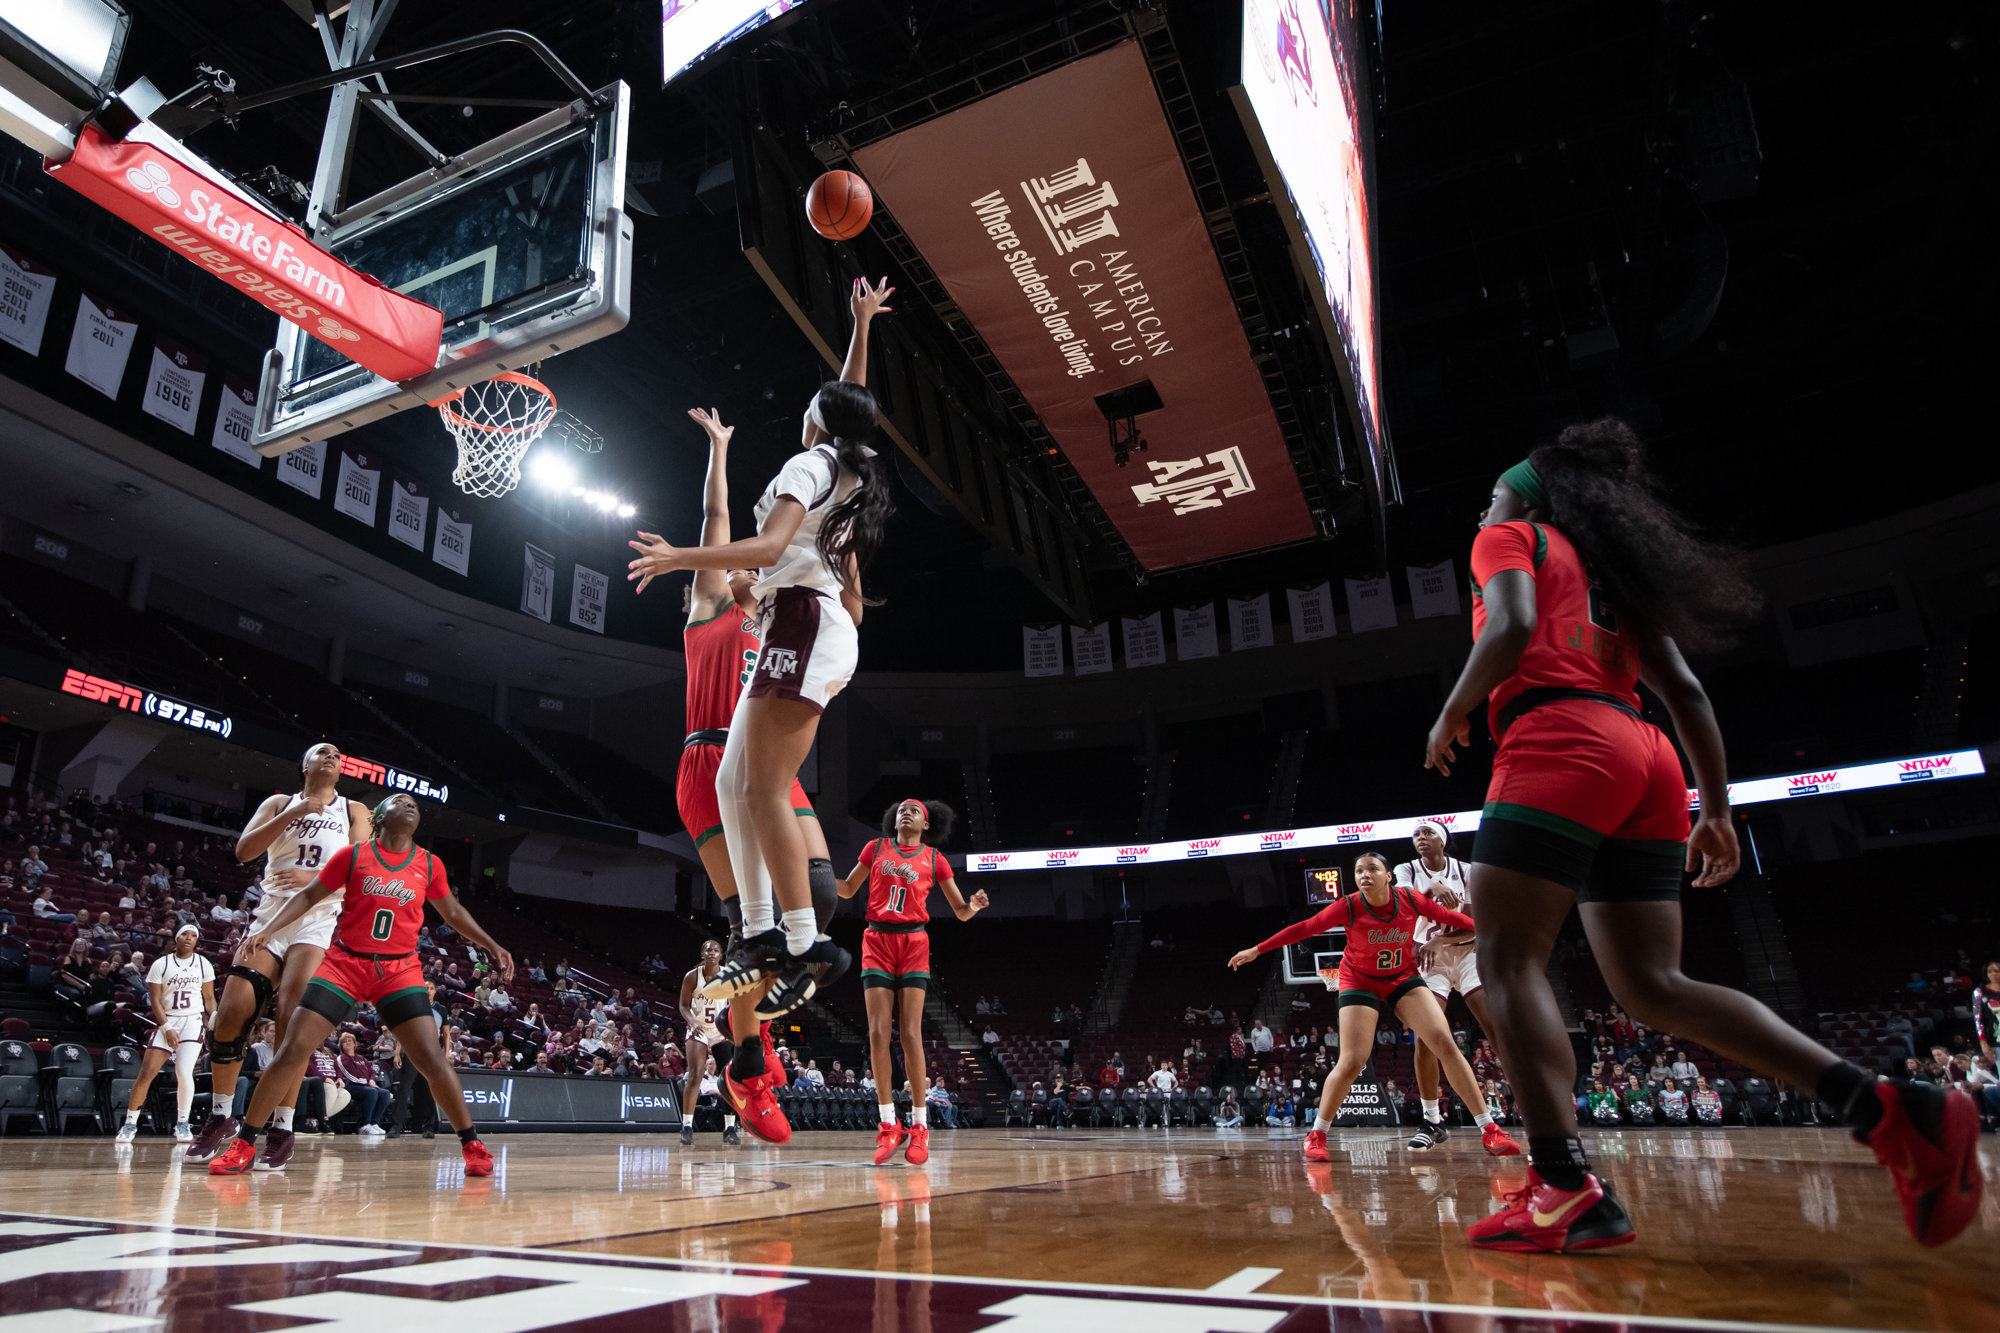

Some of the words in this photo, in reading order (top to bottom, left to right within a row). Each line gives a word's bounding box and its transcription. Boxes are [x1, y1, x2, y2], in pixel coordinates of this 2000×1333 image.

[970, 189, 1021, 252] Where
[2, 262, 21, 278] ELITE
[22, 274, 42, 290] EIGHT
[1003, 249, 1060, 315] students
[4, 277, 33, 301] 2008
[3, 290, 28, 312] 2011
[1100, 249, 1175, 358] AMERICAN
[1068, 259, 1143, 367] CAMPUS
[89, 314, 107, 328] FINAL
[109, 324, 124, 337] FOUR
[1041, 310, 1076, 343] love
[92, 327, 115, 348] 2011
[1058, 338, 1096, 380] living.
[155, 380, 192, 412] 1996
[224, 417, 252, 442] 200
[286, 451, 318, 479] 2008
[345, 482, 371, 506] 2010
[395, 508, 420, 532] 2013
[34, 536, 68, 559] 206
[441, 532, 464, 555] 2021
[580, 583, 600, 601] 2011
[1422, 584, 1444, 595] 2001
[1300, 599, 1320, 609] 1999
[1302, 607, 1321, 617] 2001
[237, 615, 263, 634] 207
[578, 607, 597, 625] 852
[1303, 615, 1323, 625] 2003
[1304, 623, 1325, 634] 2009
[404, 670, 429, 688] 208
[61, 668, 143, 713] ESPN
[157, 699, 206, 729] 97.5
[204, 718, 221, 733] FM
[538, 697, 564, 711] 209
[1896, 755, 1953, 772] WTAW
[340, 752, 386, 786] ESPN
[396, 773, 430, 796] 97.5
[1786, 771, 1838, 787] WTAW
[1898, 769, 1934, 782] NewsTalk
[1934, 766, 1958, 777] 1620
[1788, 784, 1819, 797] NewsTalk
[1819, 781, 1841, 792] 1620
[285, 816, 345, 839] Aggies
[1260, 831, 1296, 843] WTAW
[1336, 823, 1375, 835] WTAW
[1116, 846, 1151, 856] WTAW
[1187, 839, 1221, 850] WTAW
[295, 843, 323, 868] 13
[978, 854, 1011, 863] WTAW
[1047, 850, 1080, 860] WTAW
[881, 860, 920, 884] Valley
[1314, 870, 1339, 882] 4:02
[361, 875, 417, 906] Valley
[885, 884, 907, 914] 11
[1325, 881, 1339, 899] 9
[371, 908, 395, 941] 0
[1367, 928, 1410, 945] Valley
[1377, 947, 1403, 970] 21
[167, 973, 200, 989] Aggies
[171, 990, 193, 1010] 15
[704, 1007, 716, 1024] 5
[462, 1090, 510, 1104] SSAN
[1350, 1083, 1378, 1093] ELLS
[623, 1095, 671, 1109] NISSAN
